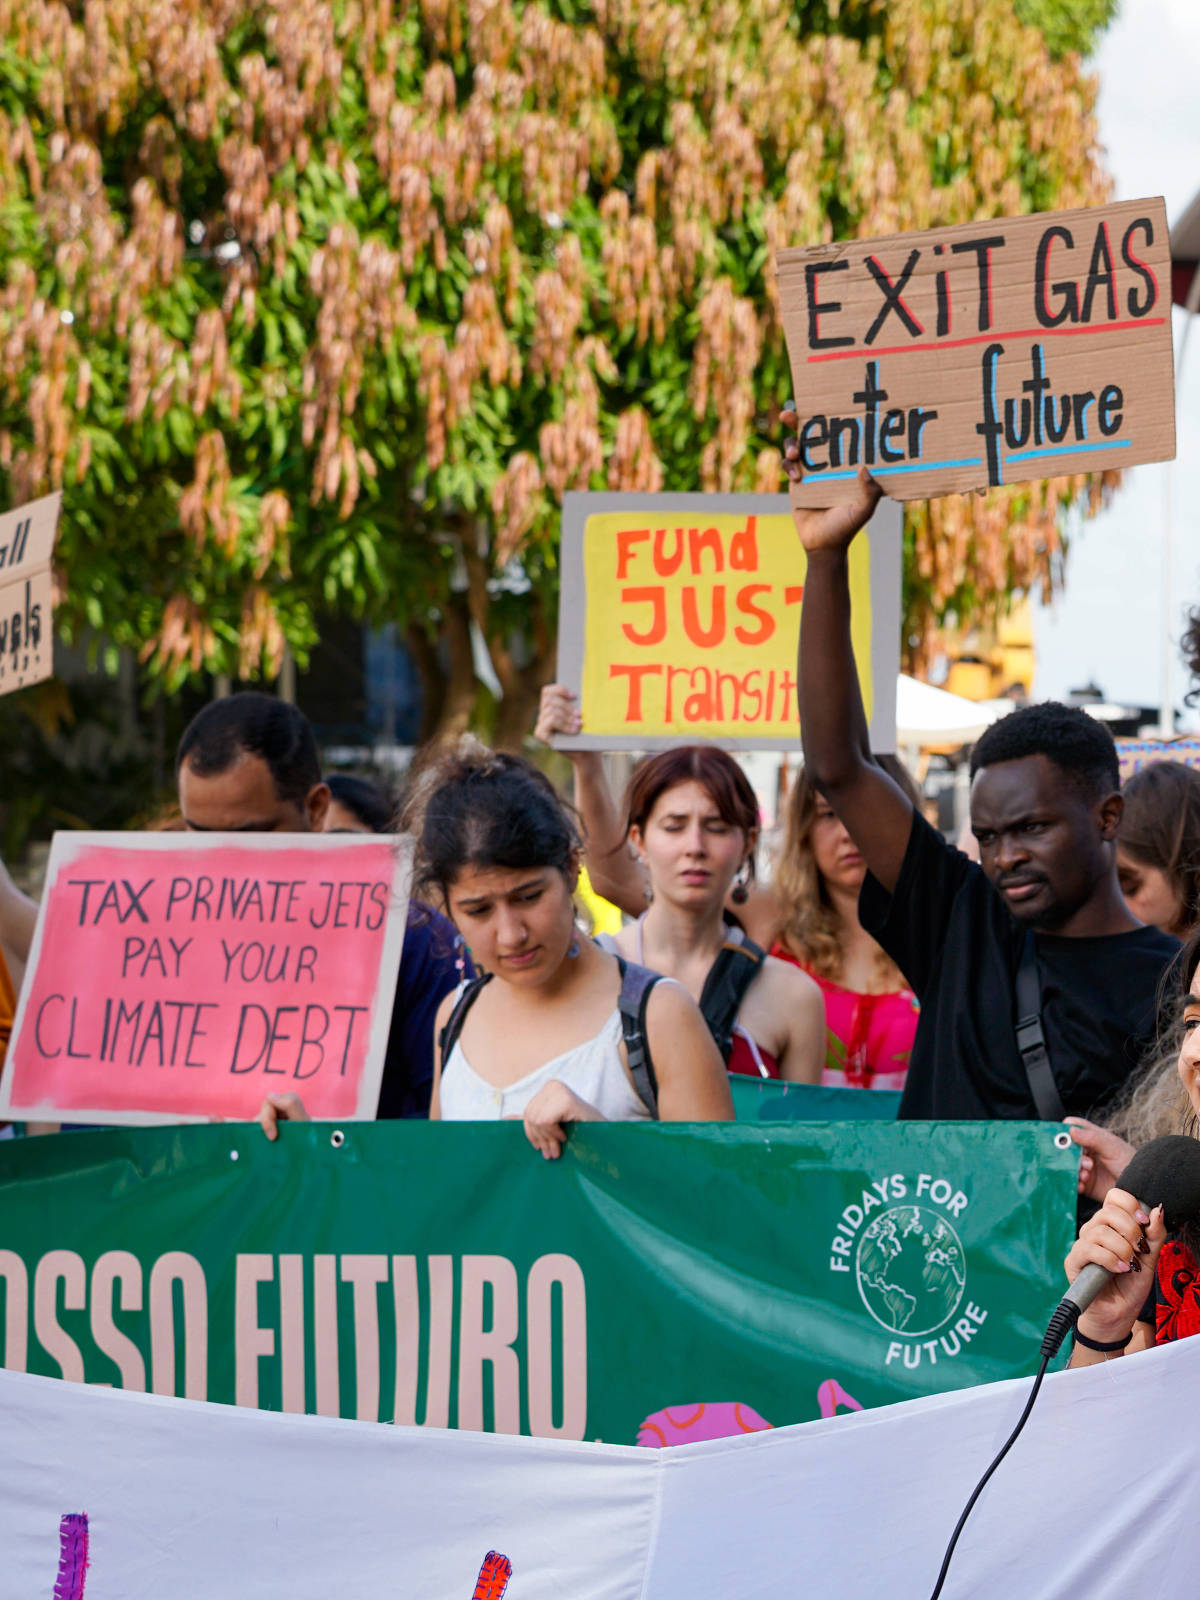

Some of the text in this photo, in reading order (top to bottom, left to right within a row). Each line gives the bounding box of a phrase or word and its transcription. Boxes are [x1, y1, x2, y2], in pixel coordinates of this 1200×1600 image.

[1034, 217, 1159, 328] GAS
[801, 343, 1124, 486] enter future
[609, 663, 801, 724] Transit
[67, 875, 390, 931] TAX PRIVATE JETS
[121, 936, 319, 984] PAY YOUR
[34, 994, 369, 1080] CLIMATE DEBT
[829, 1173, 969, 1273] FRIDAYS FOR
[235, 1252, 588, 1443] FUTURO
[884, 1300, 989, 1369] FUTURE
